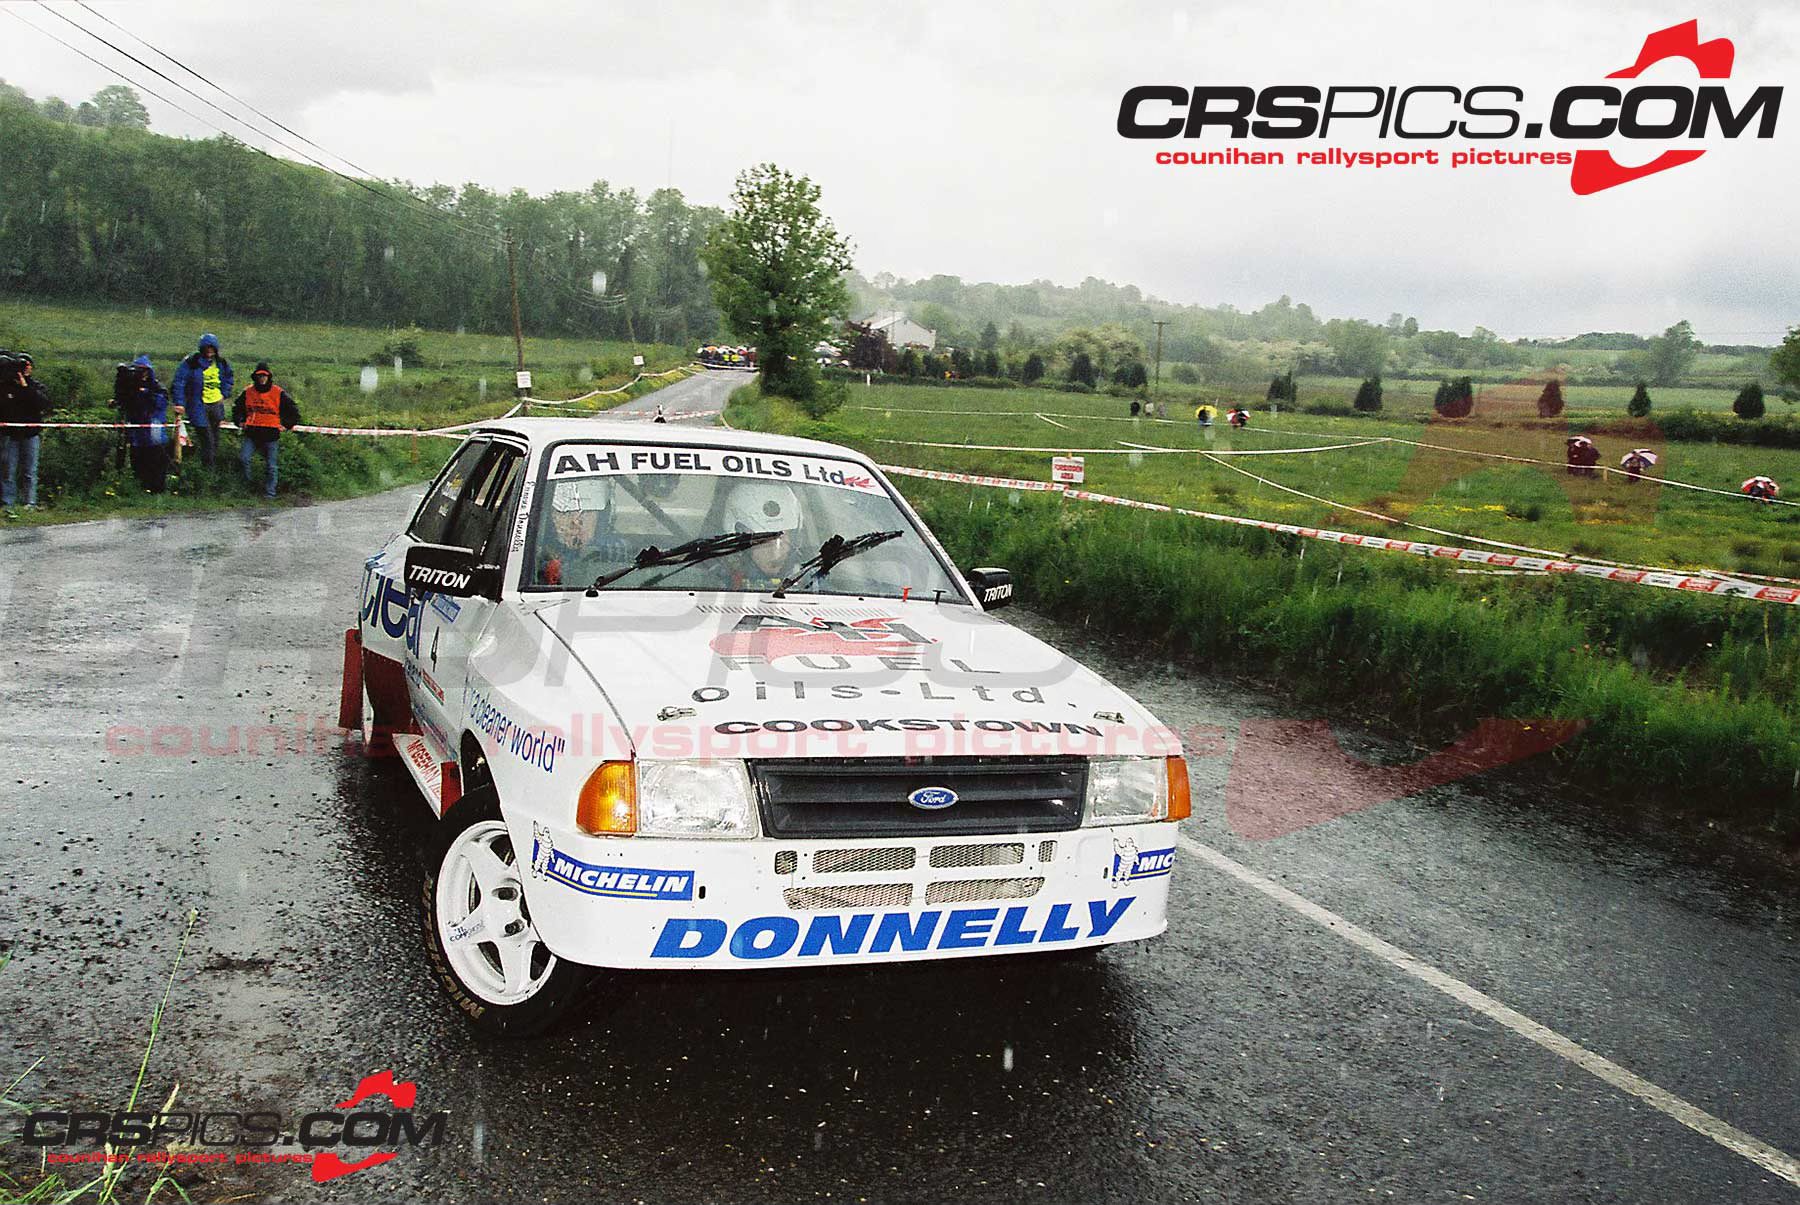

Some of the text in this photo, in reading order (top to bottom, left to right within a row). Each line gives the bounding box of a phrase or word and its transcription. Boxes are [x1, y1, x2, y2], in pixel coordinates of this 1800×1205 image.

[554, 452, 620, 475] AH
[630, 452, 711, 470] FUEL
[722, 455, 793, 477] OILS
[408, 564, 471, 590] TRITON
[983, 584, 1014, 603] TRITON
[430, 626, 441, 672] 4
[718, 655, 1001, 675] FUEL
[475, 692, 513, 746] cleaner
[511, 729, 566, 774] world"
[713, 718, 1105, 737] COOKSTOWN
[920, 791, 947, 804] Ford
[554, 856, 690, 893] MICHELIN
[649, 896, 1137, 960] DONNELLY
